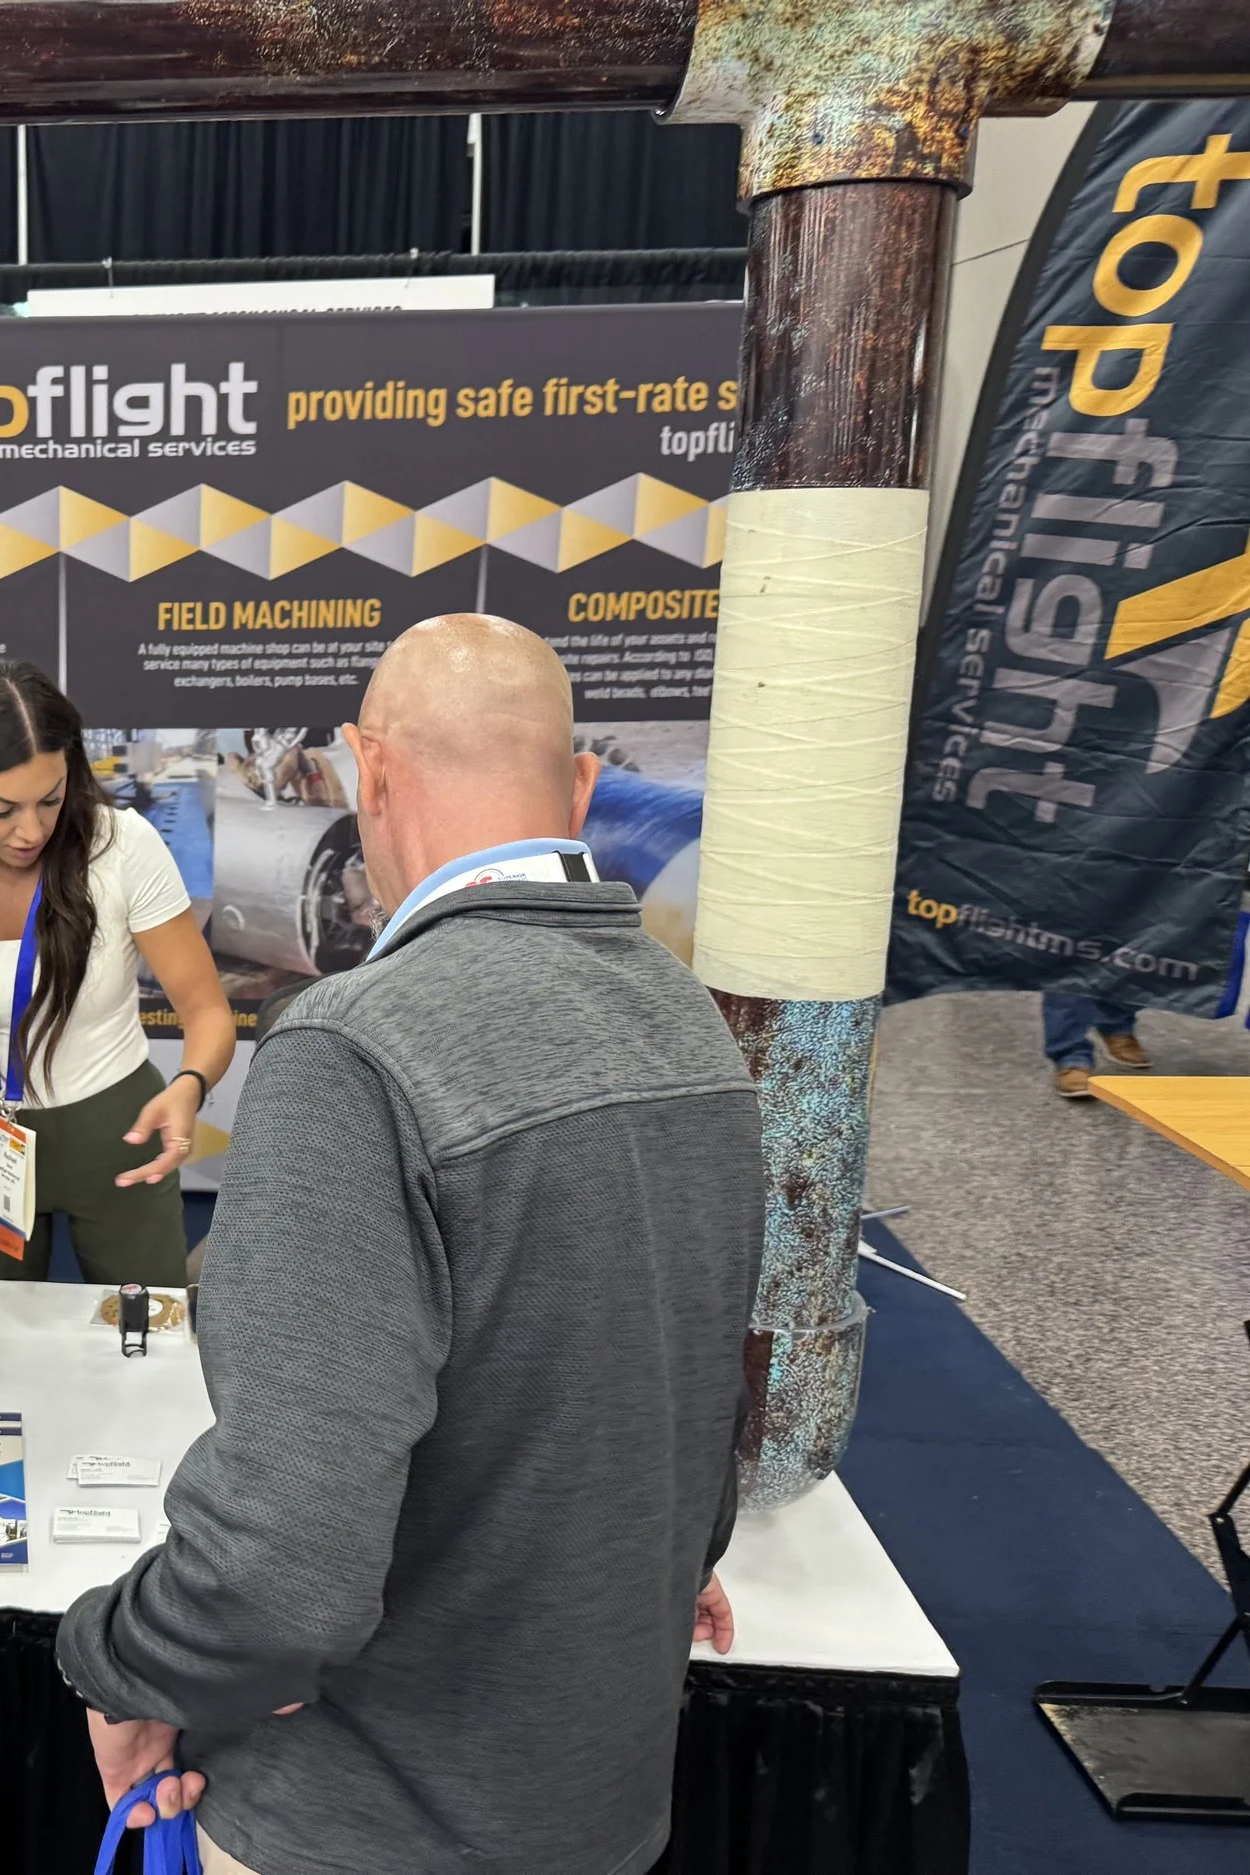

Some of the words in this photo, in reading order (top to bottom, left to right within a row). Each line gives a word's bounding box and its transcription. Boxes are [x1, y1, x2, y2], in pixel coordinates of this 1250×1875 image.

[287, 380, 448, 430] providing
[455, 378, 534, 419] safe
[543, 376, 709, 417] first-rate
[147, 437, 257, 458] services
[660, 421, 735, 462] topfli
[966, 133, 1250, 823] topflight
[974, 367, 1060, 614] mechanical
[157, 602, 227, 631] FIELD
[233, 598, 382, 630] MACHINING
[567, 589, 719, 622] COMPOSITE
[137, 643, 148, 655] A
[148, 642, 171, 657] fully
[172, 642, 218, 657] equipped
[219, 641, 264, 655] machine
[265, 642, 290, 656] shop
[291, 643, 311, 654] can
[311, 641, 326, 653] be
[339, 642, 363, 656] your
[363, 640, 385, 653] site
[143, 658, 180, 671] service
[181, 658, 210, 673] many
[211, 657, 239, 673] types
[240, 657, 252, 670] of
[253, 656, 308, 671] equipment
[309, 655, 335, 668] such
[336, 657, 349, 668] as
[174, 674, 234, 689] exchangers,
[235, 673, 273, 688] boilers,
[274, 675, 303, 688] pump
[932, 628, 993, 802] services
[906, 889, 1202, 981] topflightms.com
